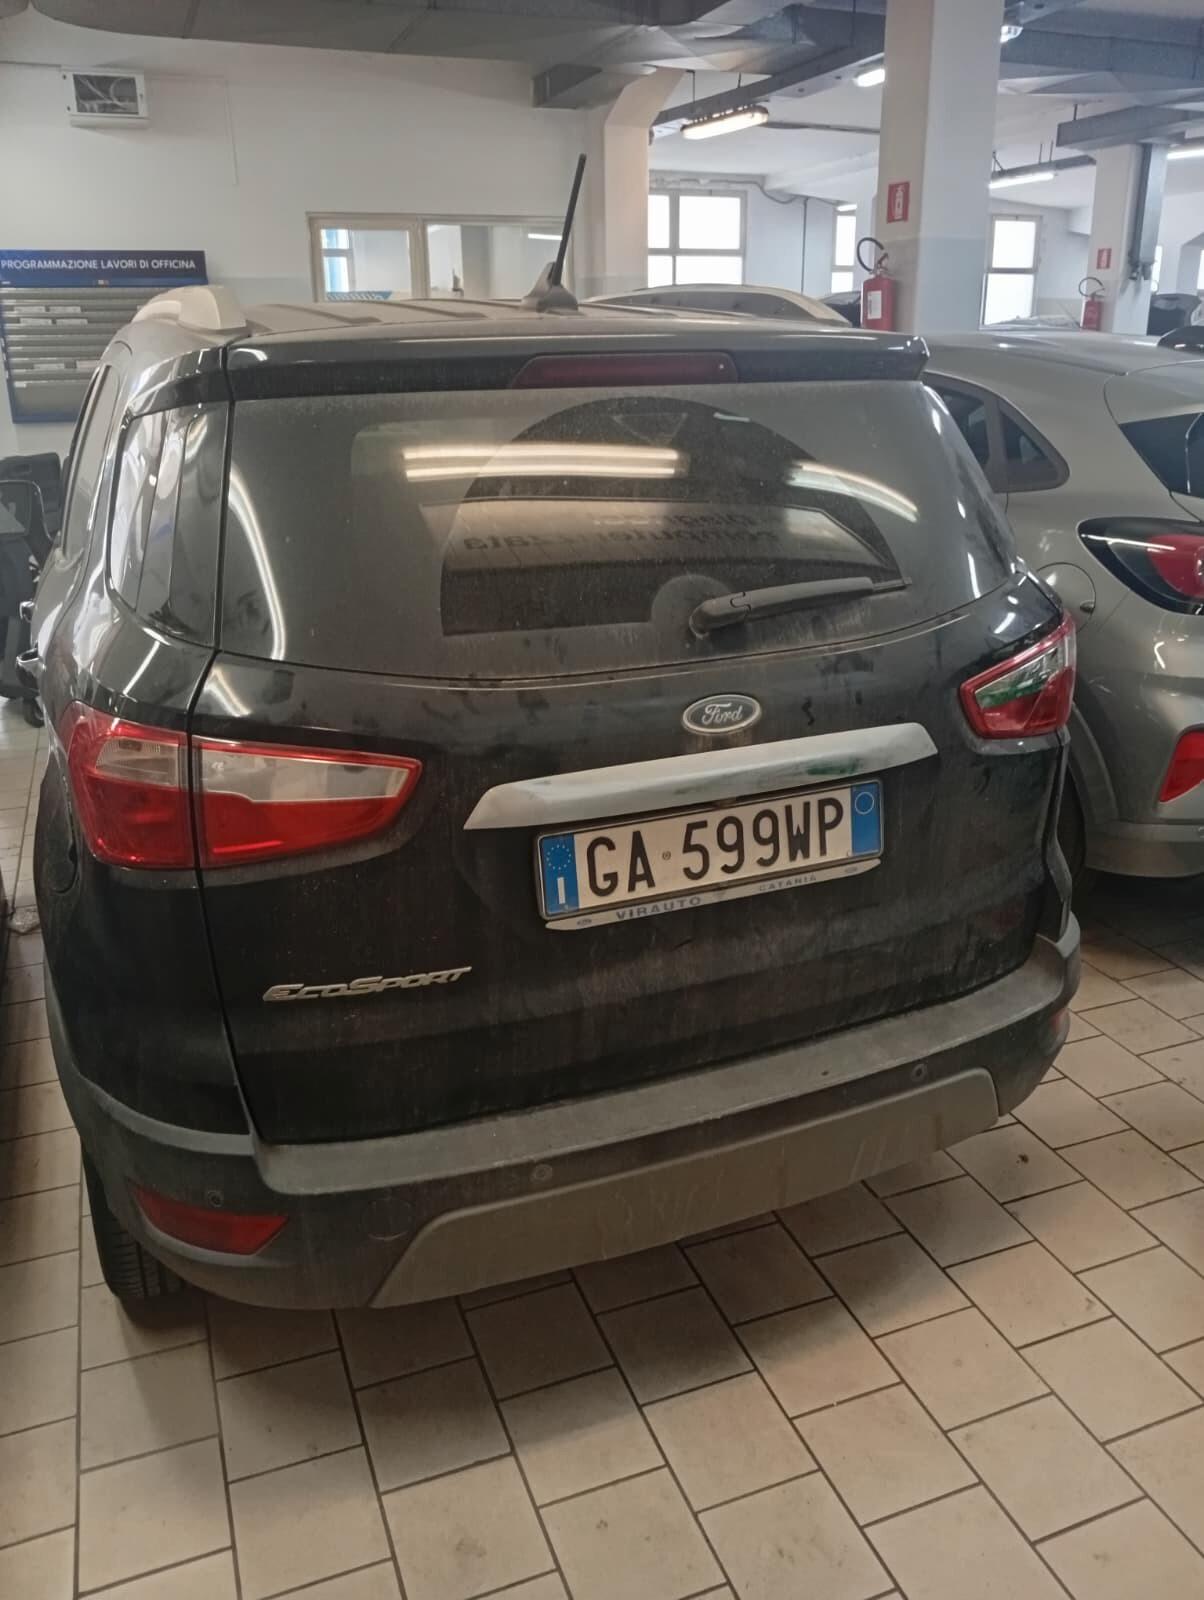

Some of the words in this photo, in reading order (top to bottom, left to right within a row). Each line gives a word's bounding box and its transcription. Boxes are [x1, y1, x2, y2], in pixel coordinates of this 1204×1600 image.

[1, 259, 98, 270] PROGRAMMAZIONE
[101, 259, 137, 270] LAVORI
[140, 259, 149, 269] DI
[151, 259, 196, 270] OFFICINA
[701, 702, 743, 726] Ford
[586, 829, 656, 898] GA
[682, 796, 844, 881] 599WP
[615, 896, 701, 920] VIRAUTO
[759, 874, 817, 892] CATANIA
